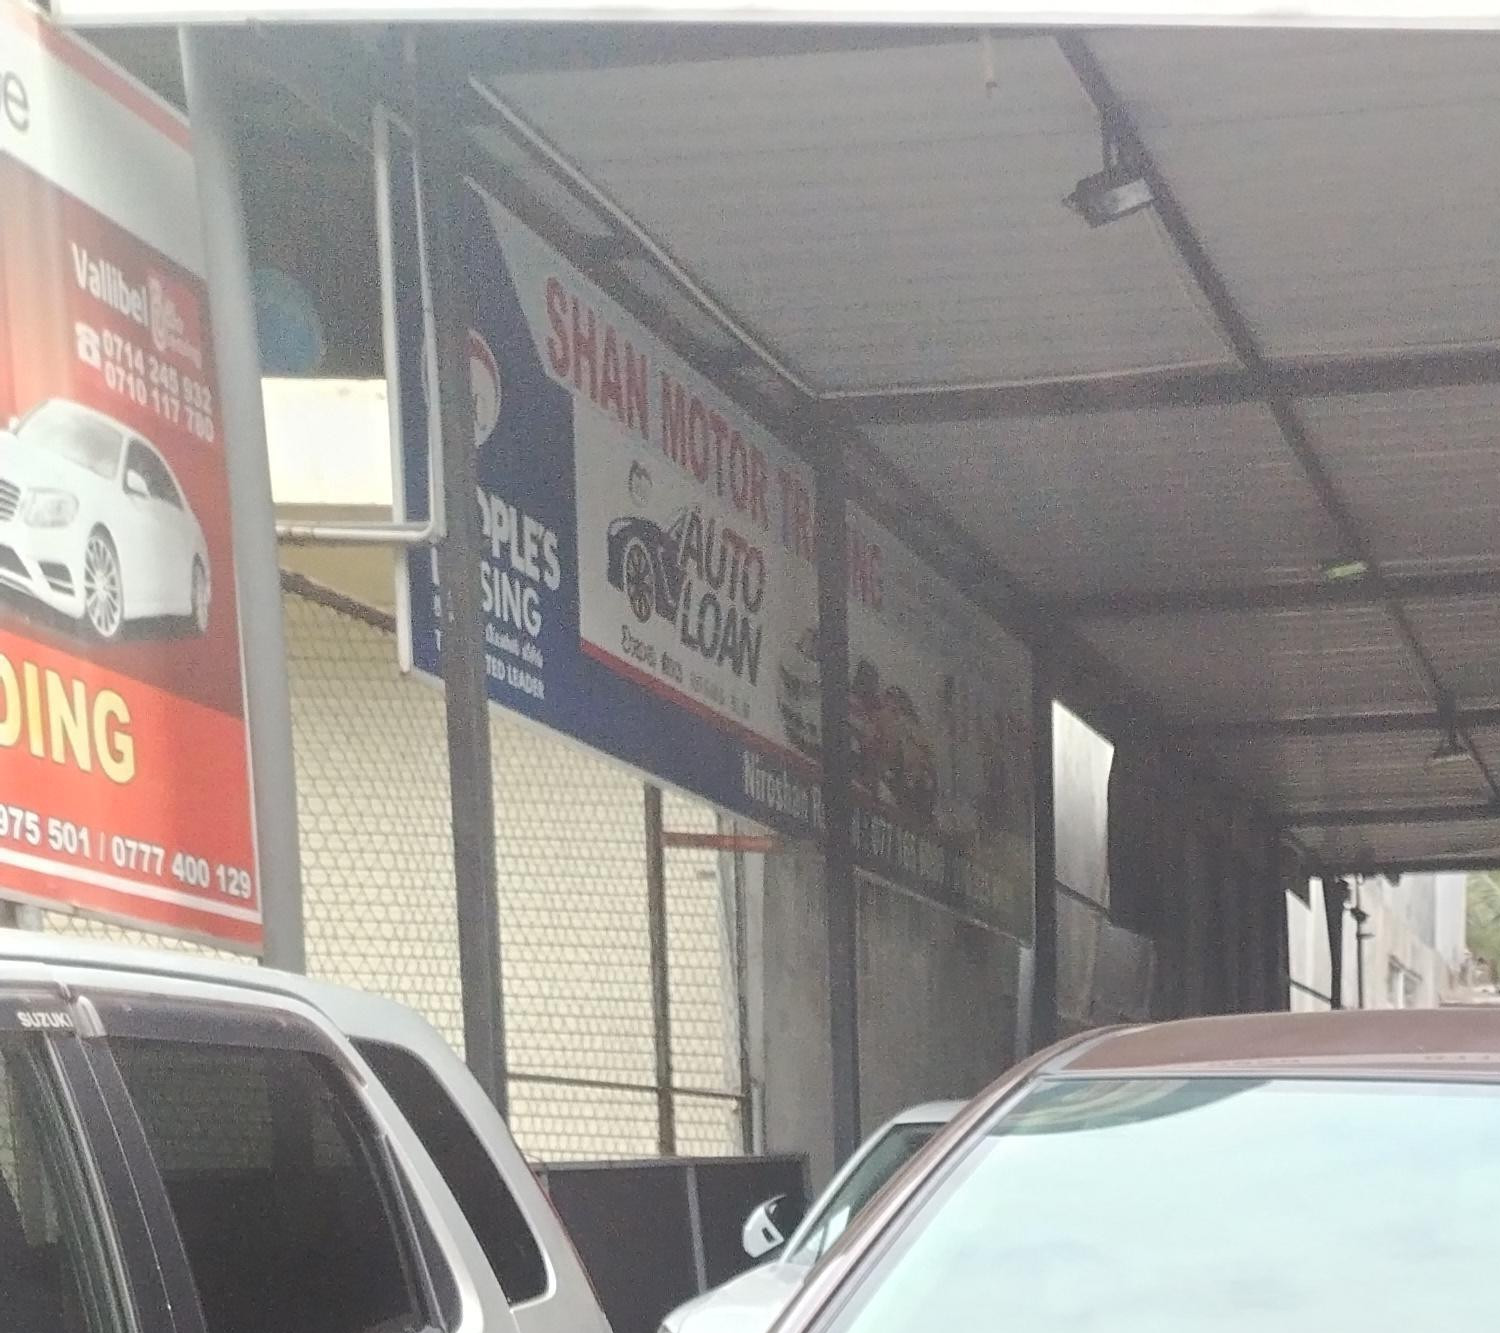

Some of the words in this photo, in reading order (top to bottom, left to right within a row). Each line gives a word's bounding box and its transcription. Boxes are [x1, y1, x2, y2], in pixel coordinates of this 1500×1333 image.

[0, 70, 30, 132] e
[546, 276, 649, 441] SHAN
[660, 371, 769, 530] MOTOR
[680, 511, 767, 613] AUTO
[680, 577, 762, 687] LOAN
[48, 817, 90, 858] 501
[111, 836, 165, 876] 0777
[171, 852, 210, 889] 400
[216, 864, 251, 899] 129
[17, 1011, 74, 1028] SUZUKI
